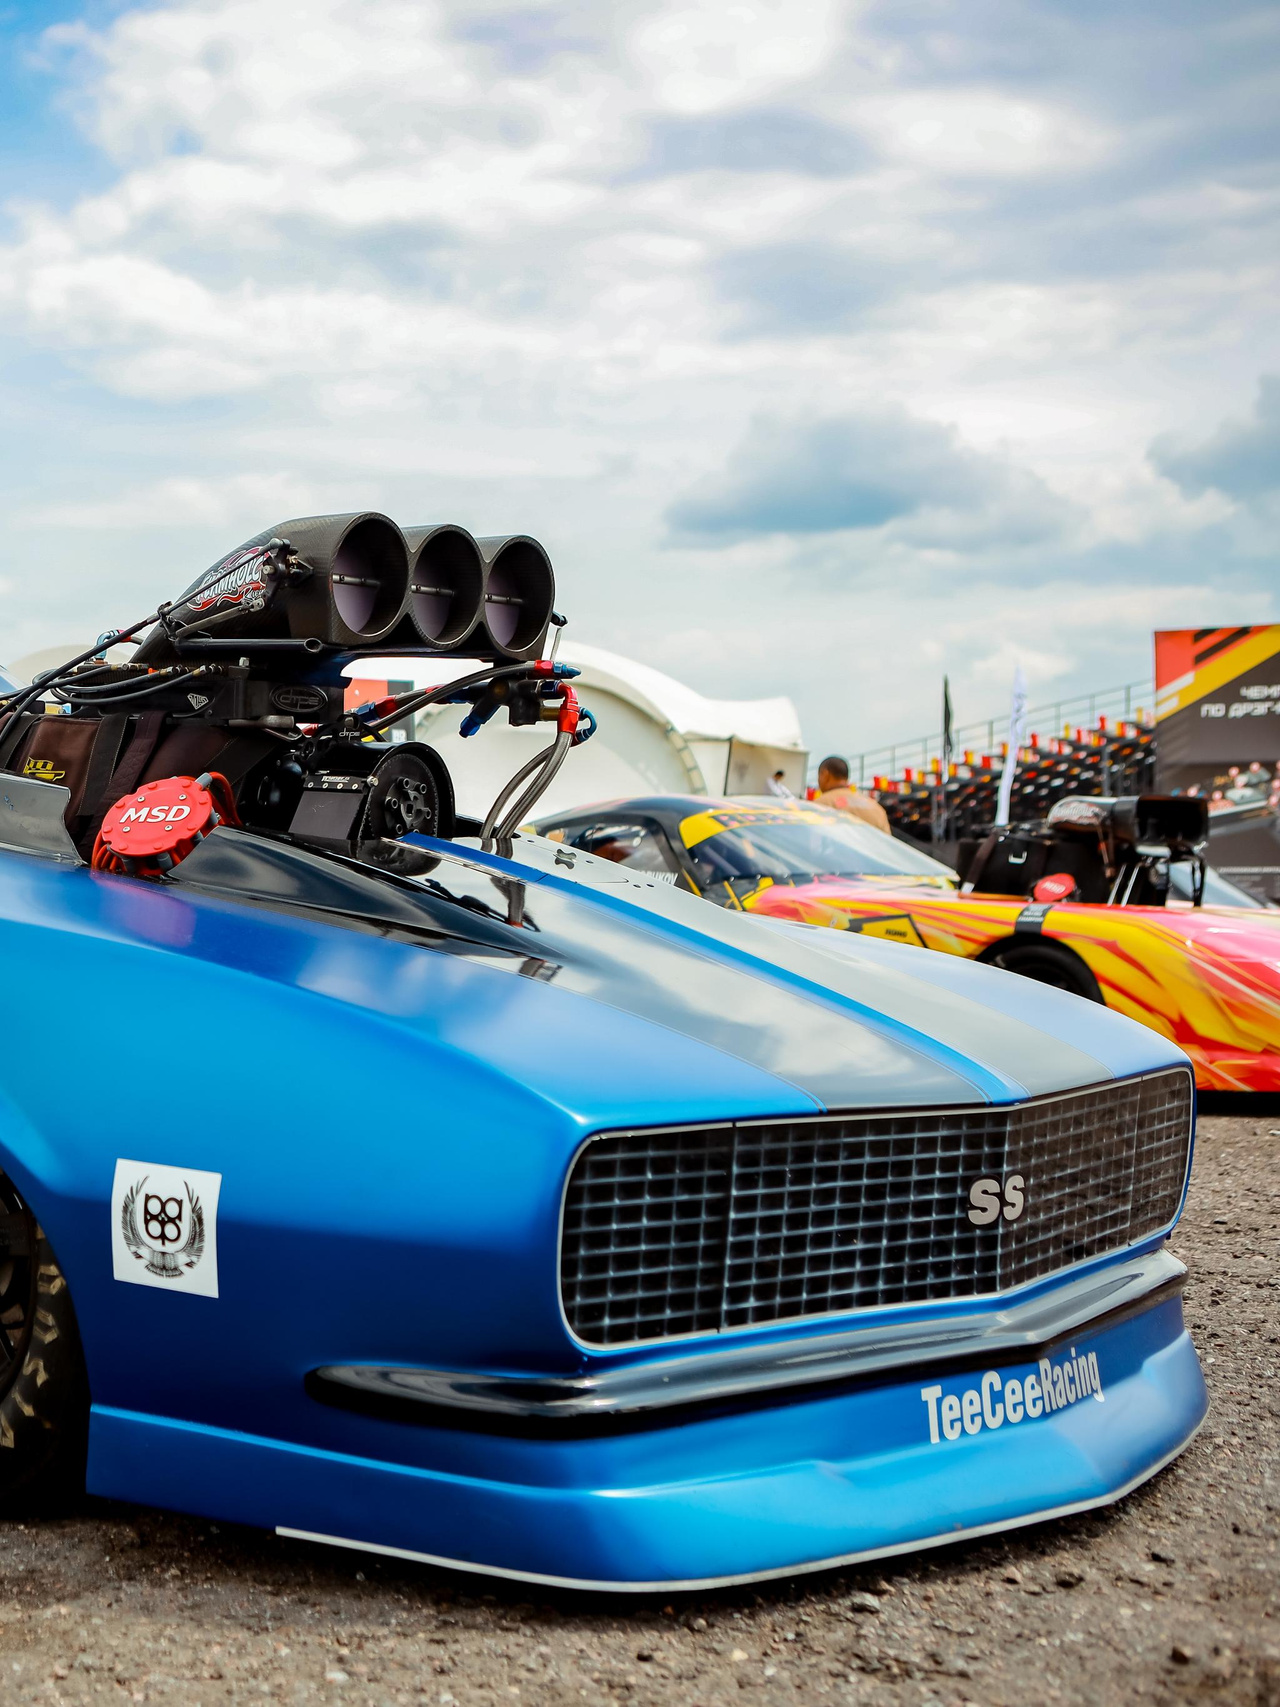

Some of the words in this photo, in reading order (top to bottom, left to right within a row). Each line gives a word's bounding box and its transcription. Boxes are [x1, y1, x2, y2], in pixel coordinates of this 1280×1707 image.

[1200, 702, 1226, 719] ПО
[118, 804, 192, 824] MSD
[967, 1174, 1025, 1226] SS
